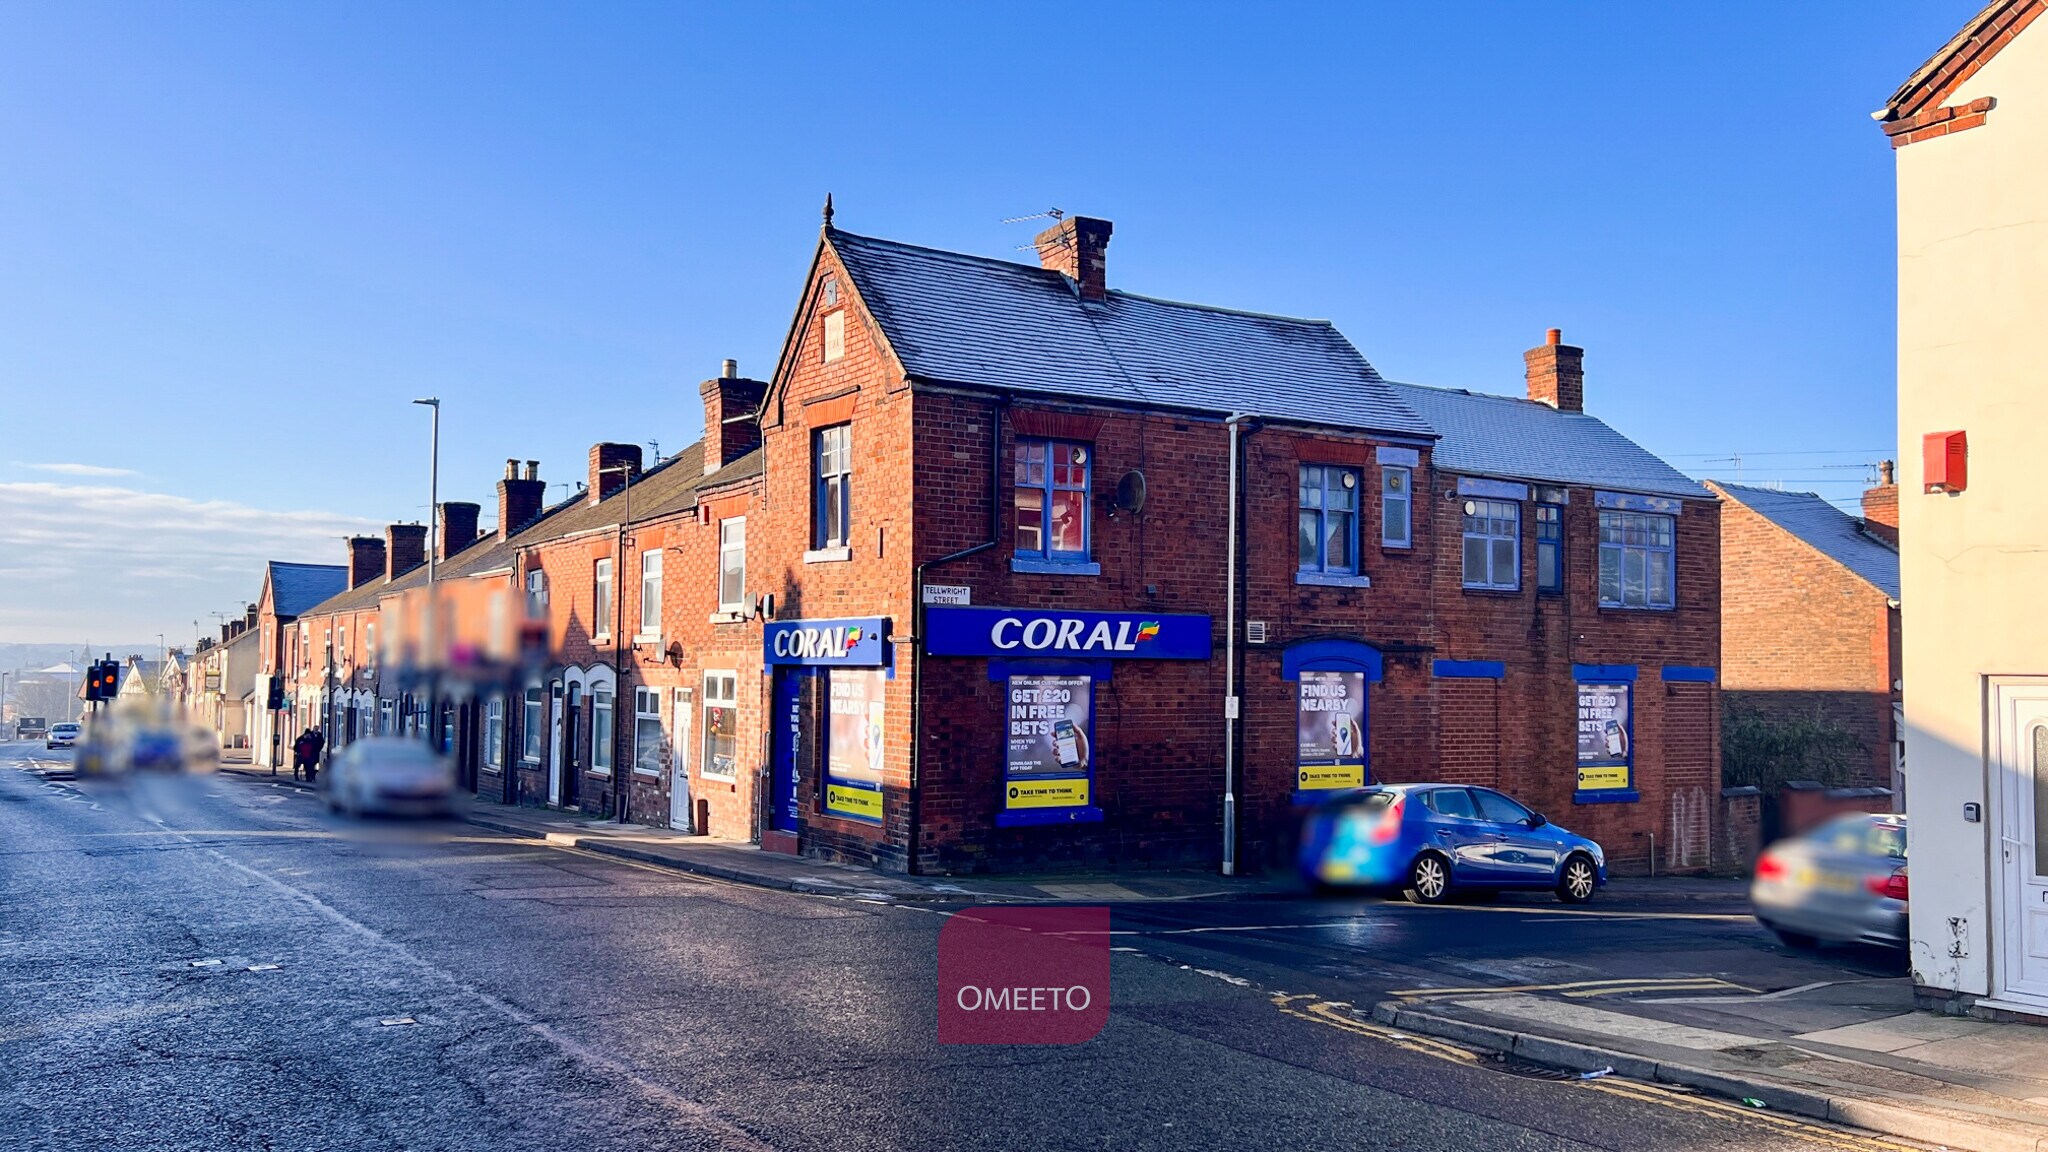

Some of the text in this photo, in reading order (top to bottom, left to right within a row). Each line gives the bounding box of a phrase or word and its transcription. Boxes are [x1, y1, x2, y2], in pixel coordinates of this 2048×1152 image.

[925, 586, 967, 596] TELLWRIGHT
[933, 596, 959, 605] STREET
[991, 618, 1136, 651] CORAL
[774, 626, 848, 658] CORAL
[831, 682, 865, 698] FIND US
[1011, 688, 1071, 703] GET £20
[1301, 684, 1346, 698] FIND US
[831, 699, 866, 715] NEARBY
[1301, 698, 1349, 712] NEARBY
[1579, 695, 1616, 707] GET £20
[1011, 705, 1065, 719] IN FREE
[1579, 707, 1612, 719] IN FREE
[1011, 720, 1049, 736] BETS
[1579, 720, 1602, 732] BETS
